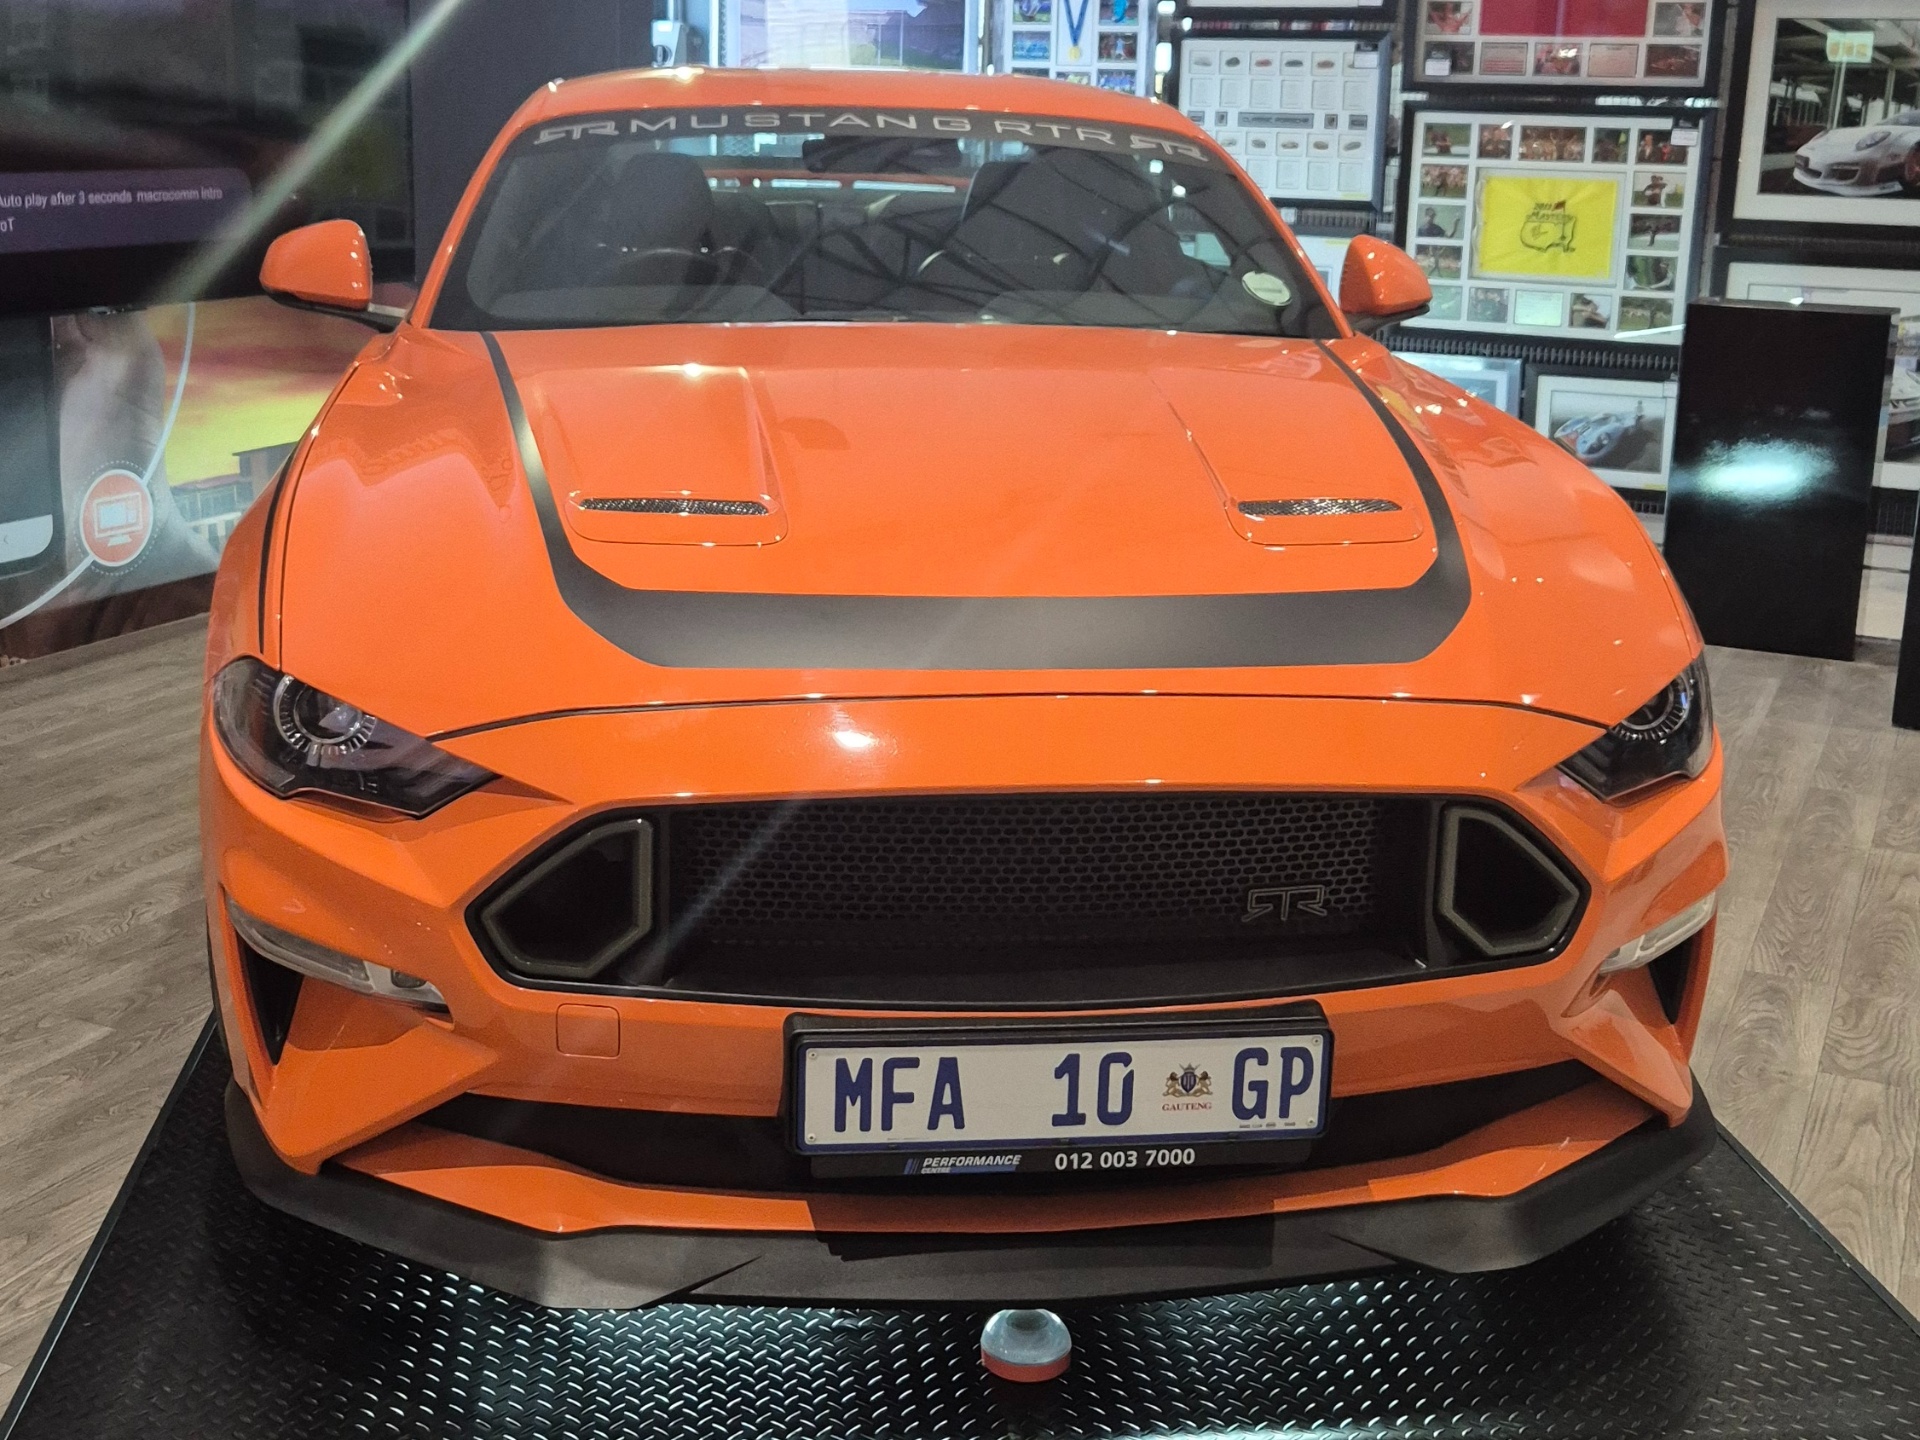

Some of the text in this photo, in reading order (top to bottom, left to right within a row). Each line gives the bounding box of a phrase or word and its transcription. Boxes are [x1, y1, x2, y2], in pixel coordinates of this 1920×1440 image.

[630, 112, 972, 133] MUSTANG
[994, 120, 1115, 145] RTR
[24, 193, 48, 209] play
[50, 191, 76, 206] after
[88, 189, 132, 204] seconds
[834, 1046, 1315, 1132] MFA 10 GP
[1161, 1101, 1213, 1112] GAUTENG
[922, 1154, 1022, 1168] PERFORMANCE
[1055, 1148, 1195, 1170] 012 003 7000
[920, 1166, 951, 1174] CENTRE
